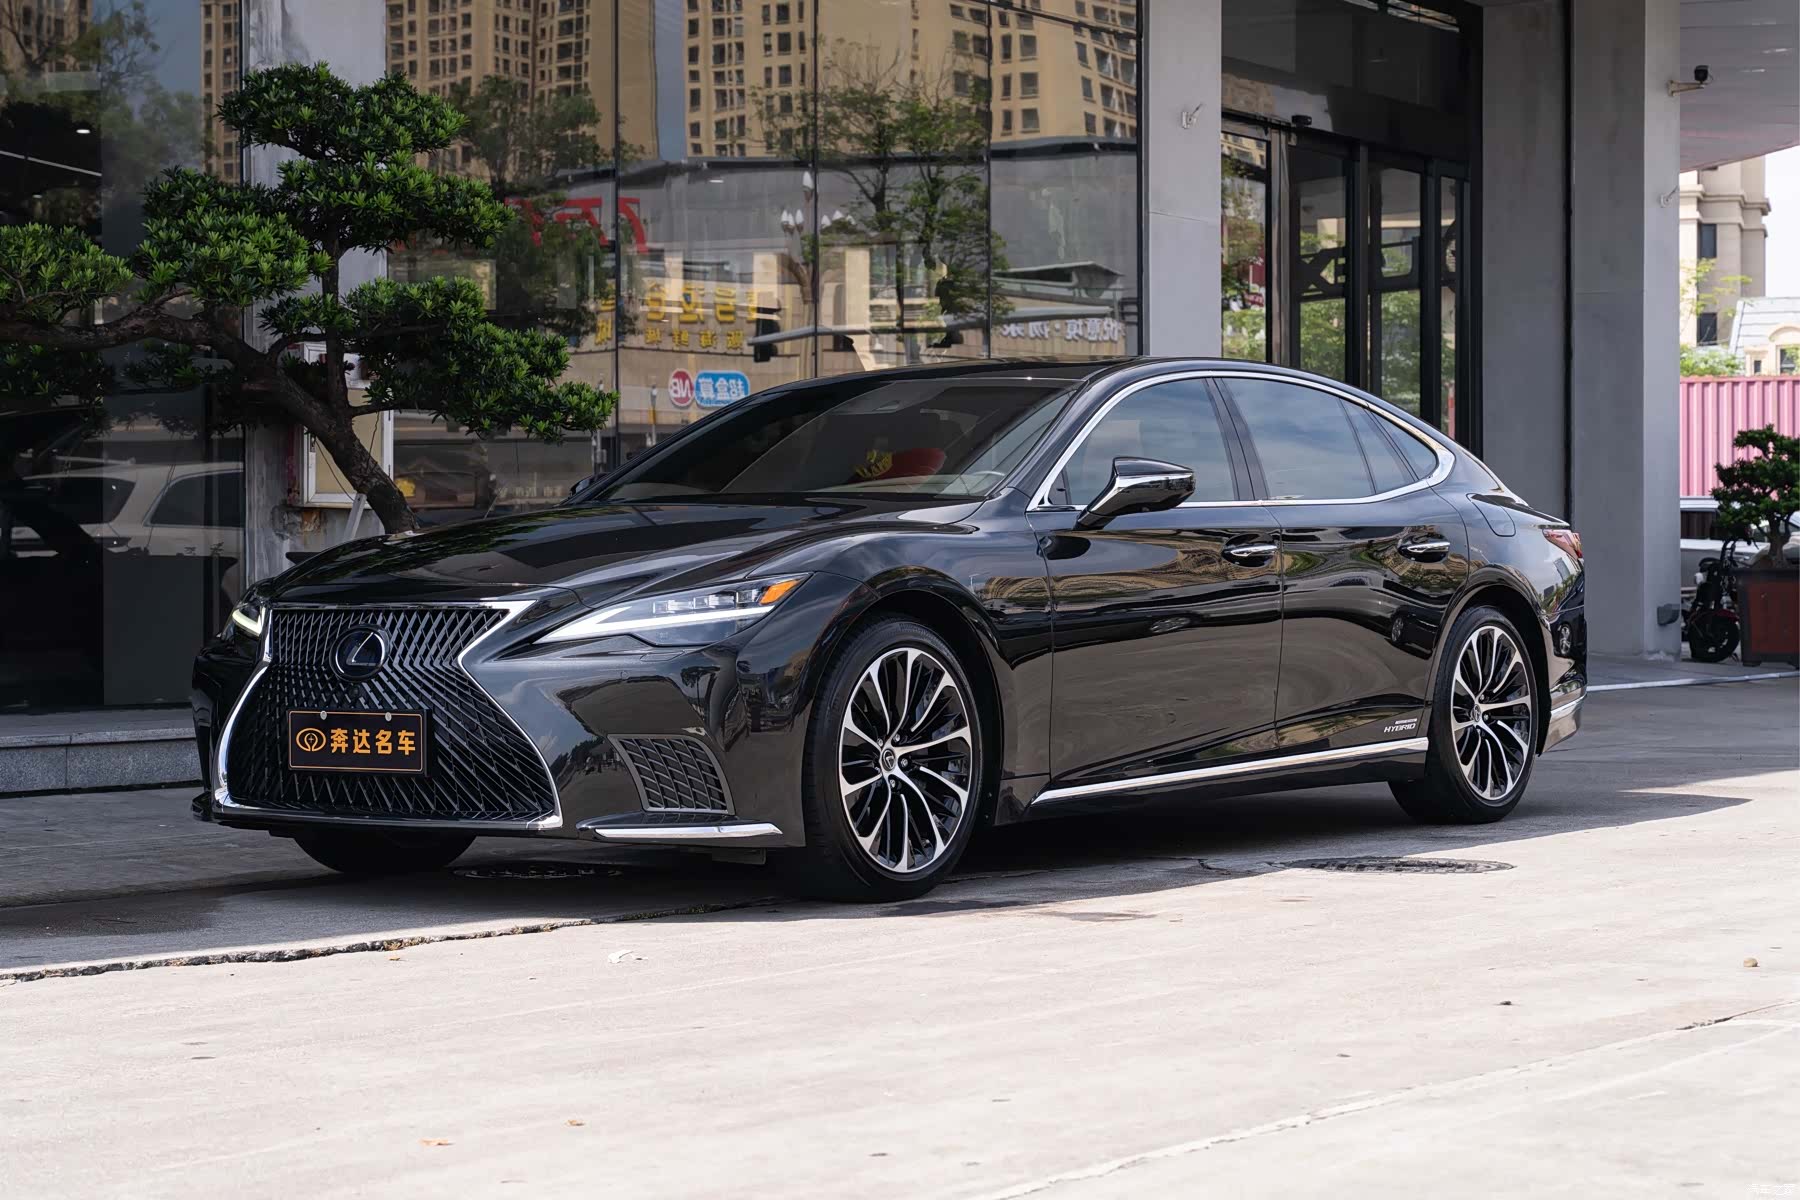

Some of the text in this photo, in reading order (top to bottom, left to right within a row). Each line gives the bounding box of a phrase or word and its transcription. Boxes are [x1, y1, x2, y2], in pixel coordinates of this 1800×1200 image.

[1383, 723, 1416, 733] HYBRID
[330, 728, 415, 755] 奔达名车
